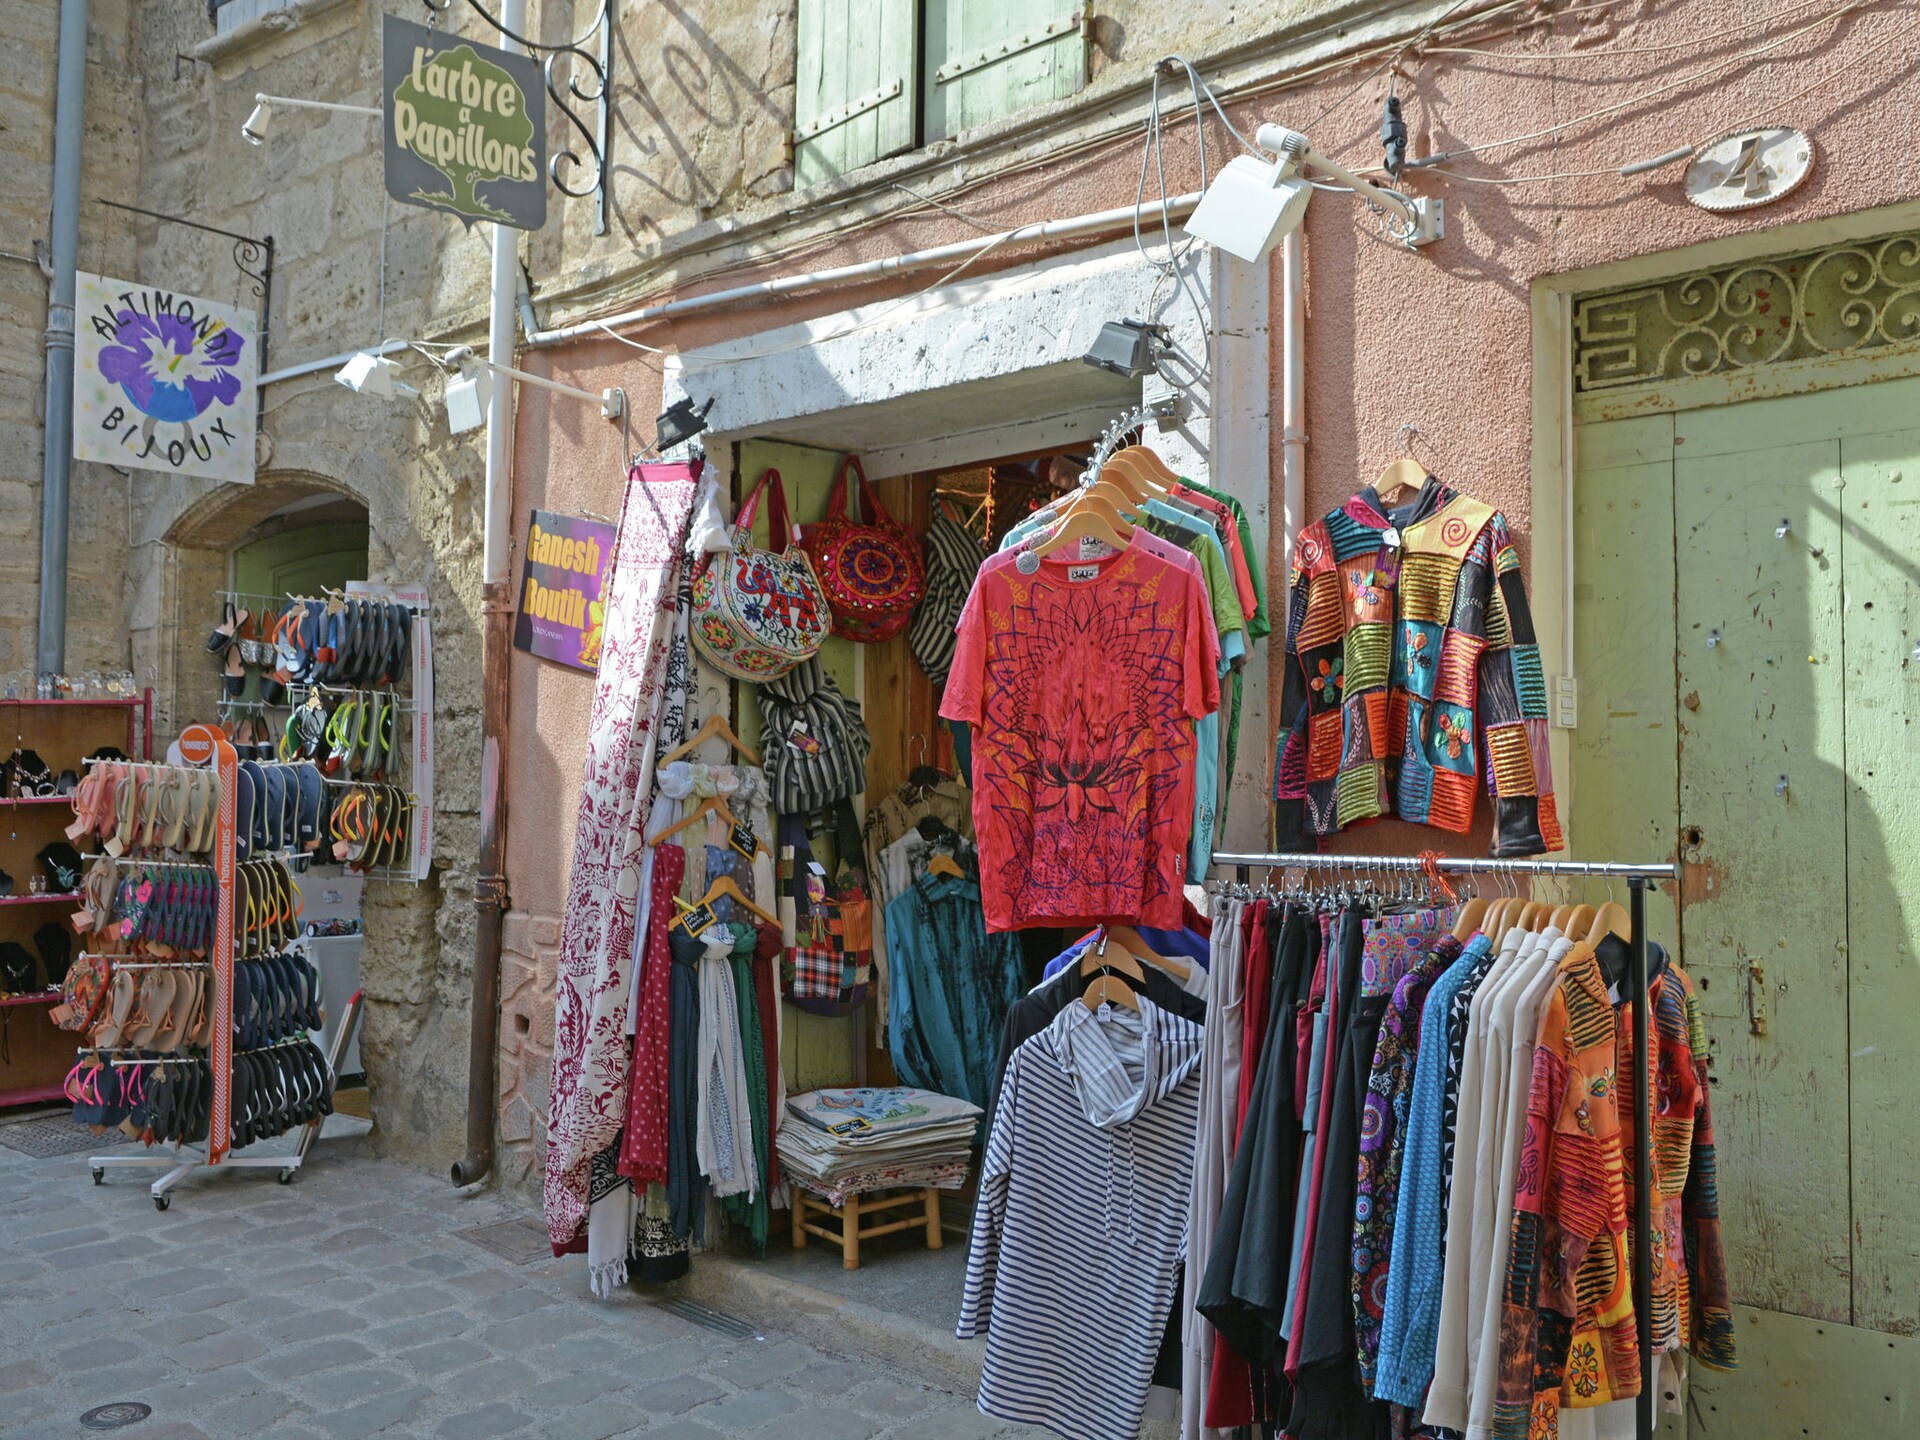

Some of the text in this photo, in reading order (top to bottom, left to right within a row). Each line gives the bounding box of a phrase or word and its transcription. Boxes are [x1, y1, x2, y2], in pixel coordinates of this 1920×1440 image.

[91, 290, 236, 360] ALTIMONDI
[101, 406, 236, 467] BIJOUX
[527, 523, 600, 576] Ganesh
[523, 577, 588, 629] Boutik
